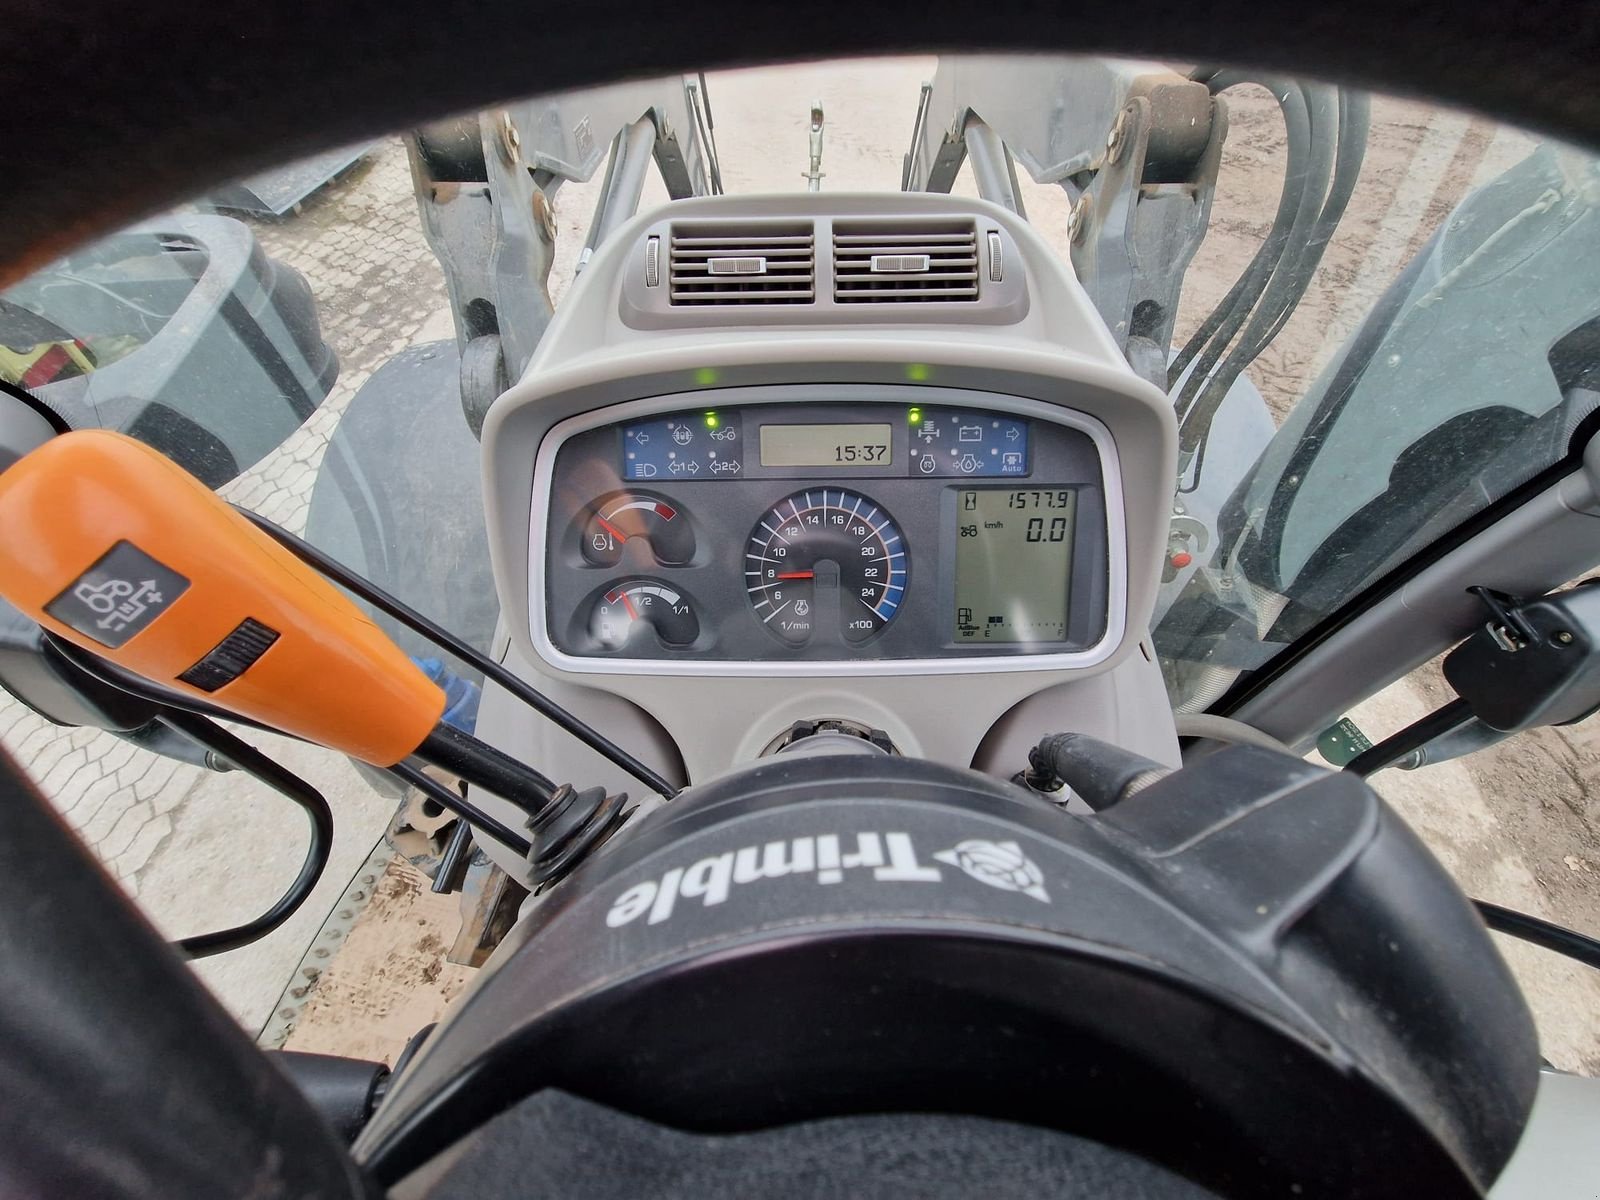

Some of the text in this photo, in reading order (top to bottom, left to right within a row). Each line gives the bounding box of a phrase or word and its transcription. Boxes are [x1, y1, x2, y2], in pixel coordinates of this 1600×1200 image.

[835, 445, 888, 462] 15:37
[721, 461, 729, 471] 2
[1002, 464, 1022, 473] Auto
[1009, 491, 1069, 509] 1577.9
[806, 515, 819, 524] 14
[831, 515, 844, 524] 16
[984, 520, 1004, 529] km/h
[785, 527, 799, 536] 12
[852, 526, 865, 535] 18
[1026, 517, 1067, 543] 0.0
[773, 548, 786, 557] 10
[861, 547, 875, 556] 20
[767, 569, 776, 578] 8
[864, 568, 878, 577] 22
[774, 591, 782, 600] 6
[861, 588, 875, 597] 24
[672, 605, 689, 615] 1/1
[781, 621, 810, 630] 1/min
[849, 620, 873, 629] x100
[984, 630, 991, 638] E
[605, 831, 943, 928] Trimble
